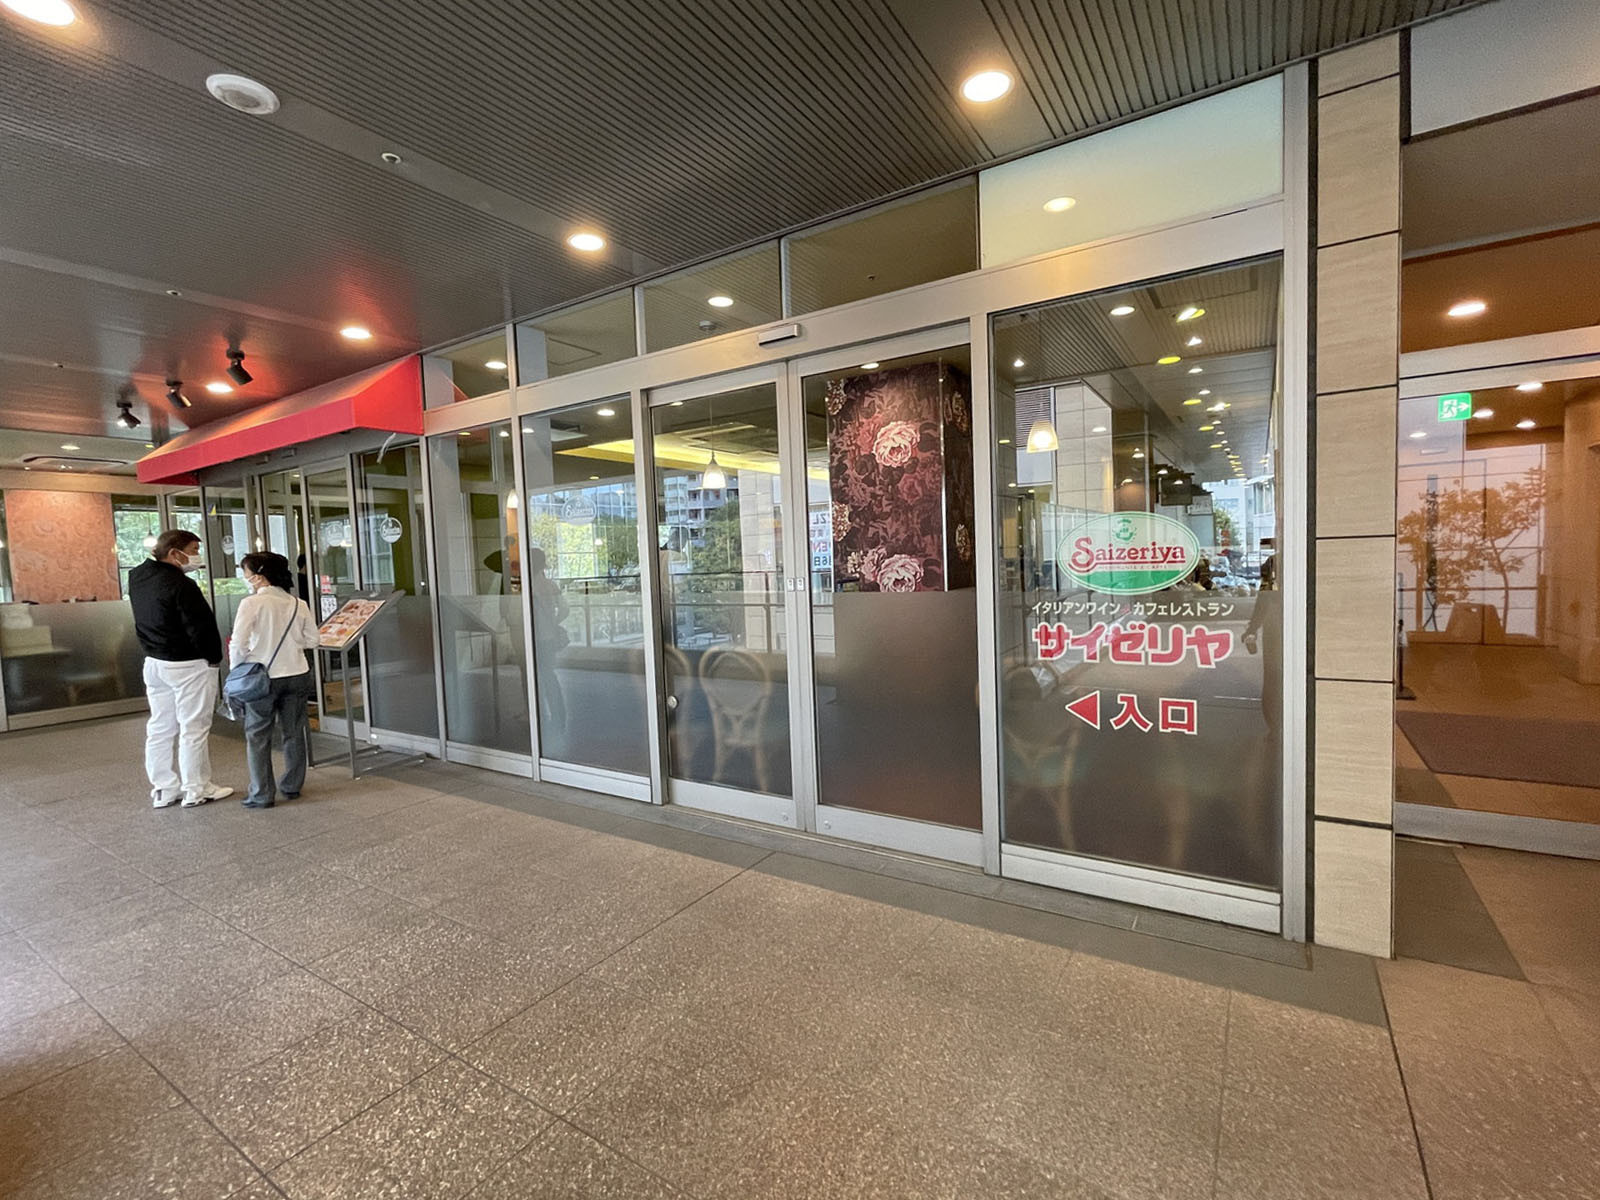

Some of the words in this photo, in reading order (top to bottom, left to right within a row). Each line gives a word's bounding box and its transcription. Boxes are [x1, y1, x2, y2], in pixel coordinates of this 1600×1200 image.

[1071, 537, 1185, 569] Saizeriya
[1031, 602, 1121, 615] イタリアンワイン
[1133, 602, 1235, 616] カフェレストラン
[1032, 622, 1233, 668] サイゼリヤ
[1110, 694, 1198, 735] 入口
